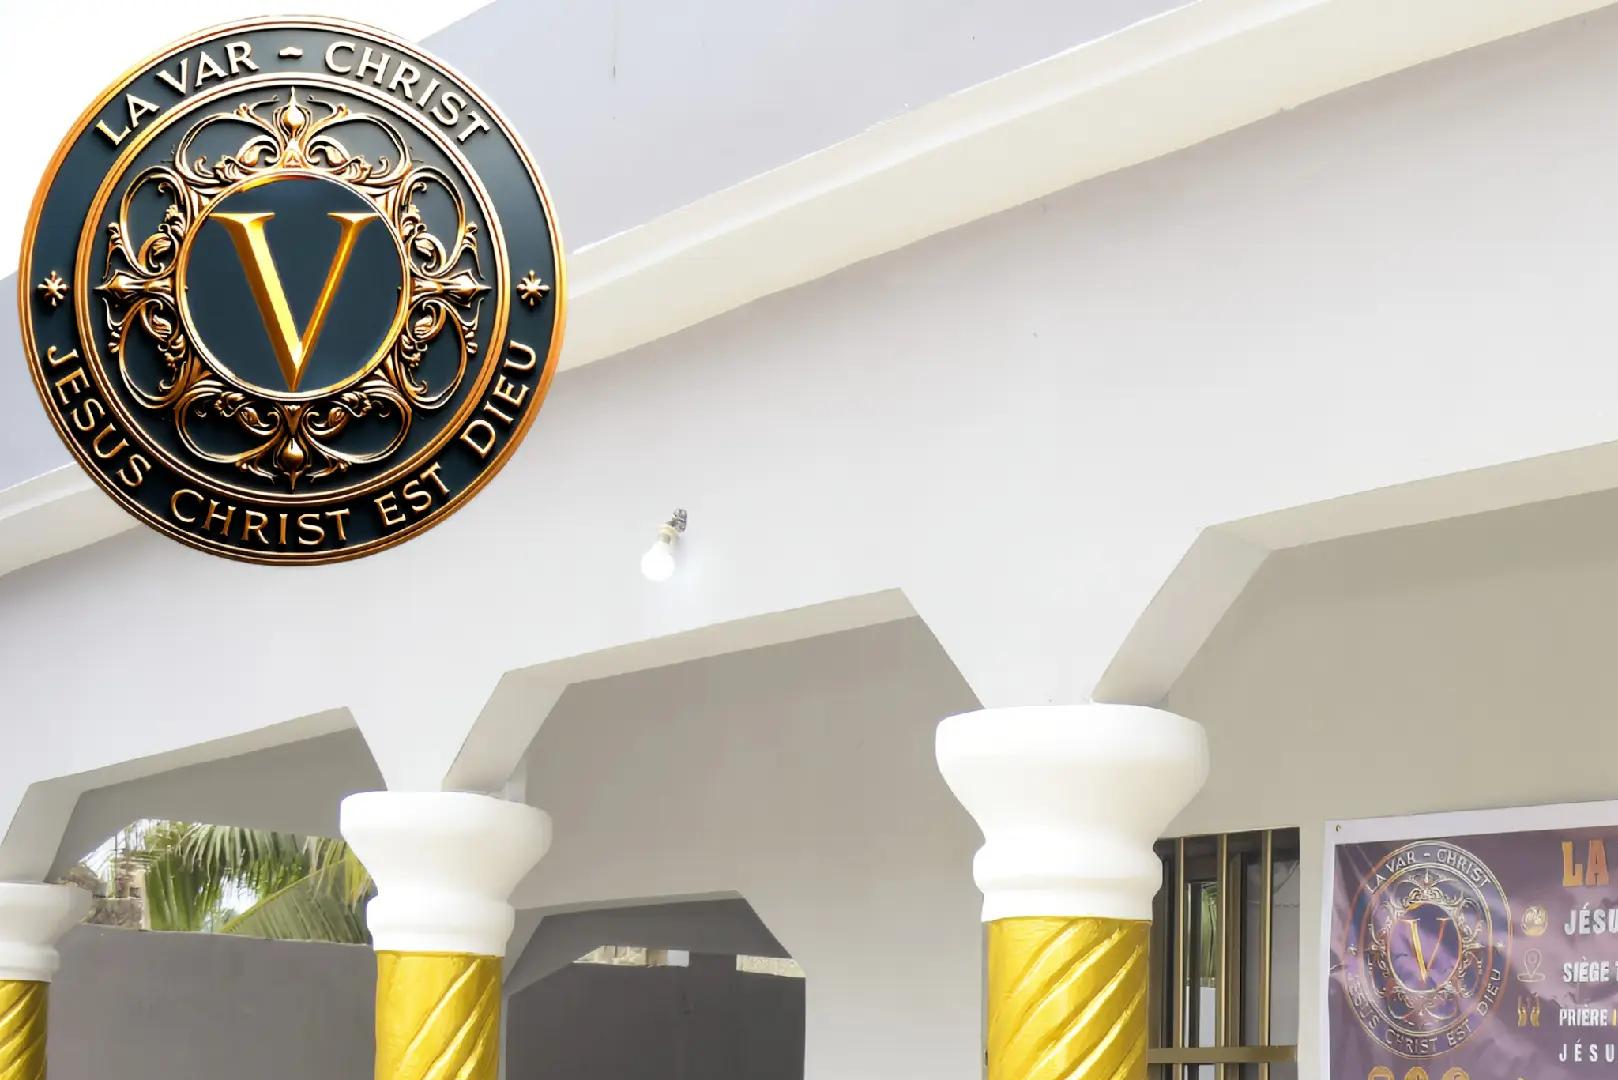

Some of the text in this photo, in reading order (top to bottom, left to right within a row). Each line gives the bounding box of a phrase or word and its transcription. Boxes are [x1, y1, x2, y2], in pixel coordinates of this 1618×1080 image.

[1366, 874, 1387, 895] LA
[1386, 850, 1417, 873] VAR
[1436, 848, 1492, 888] CHRIST
[1561, 839, 1610, 888] LA
[1399, 917, 1450, 984] V
[1563, 955, 1610, 983] SIÈGE
[1446, 1018, 1472, 1046] EST
[1476, 968, 1502, 1017] DIEU
[1559, 1003, 1608, 1027] PRIÈRE
